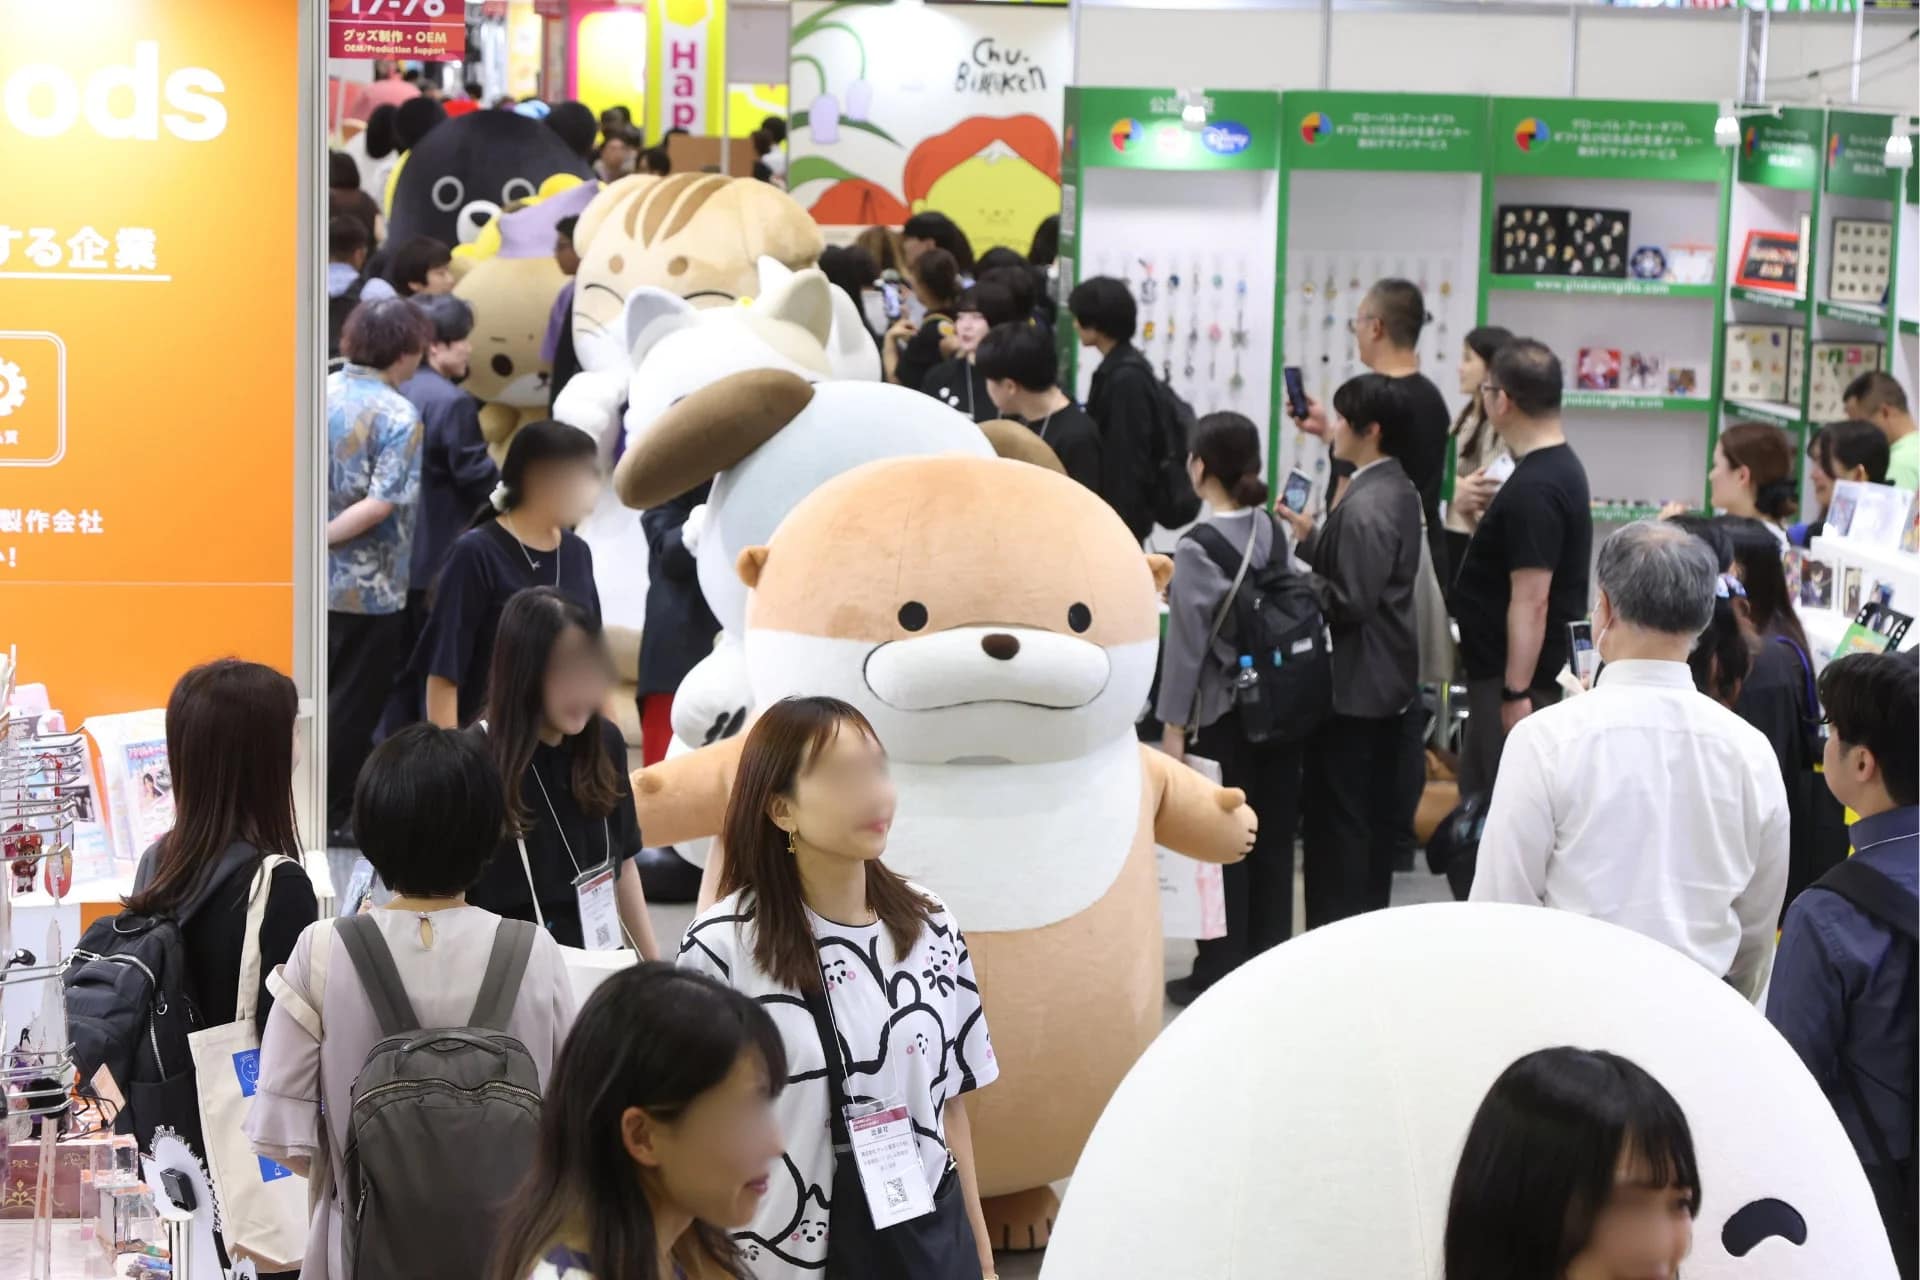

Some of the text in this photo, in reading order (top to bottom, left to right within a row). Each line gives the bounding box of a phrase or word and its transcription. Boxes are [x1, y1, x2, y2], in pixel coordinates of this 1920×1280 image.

[343, 44, 446, 56] OEM/Production Support
[3, 40, 229, 142] ods
